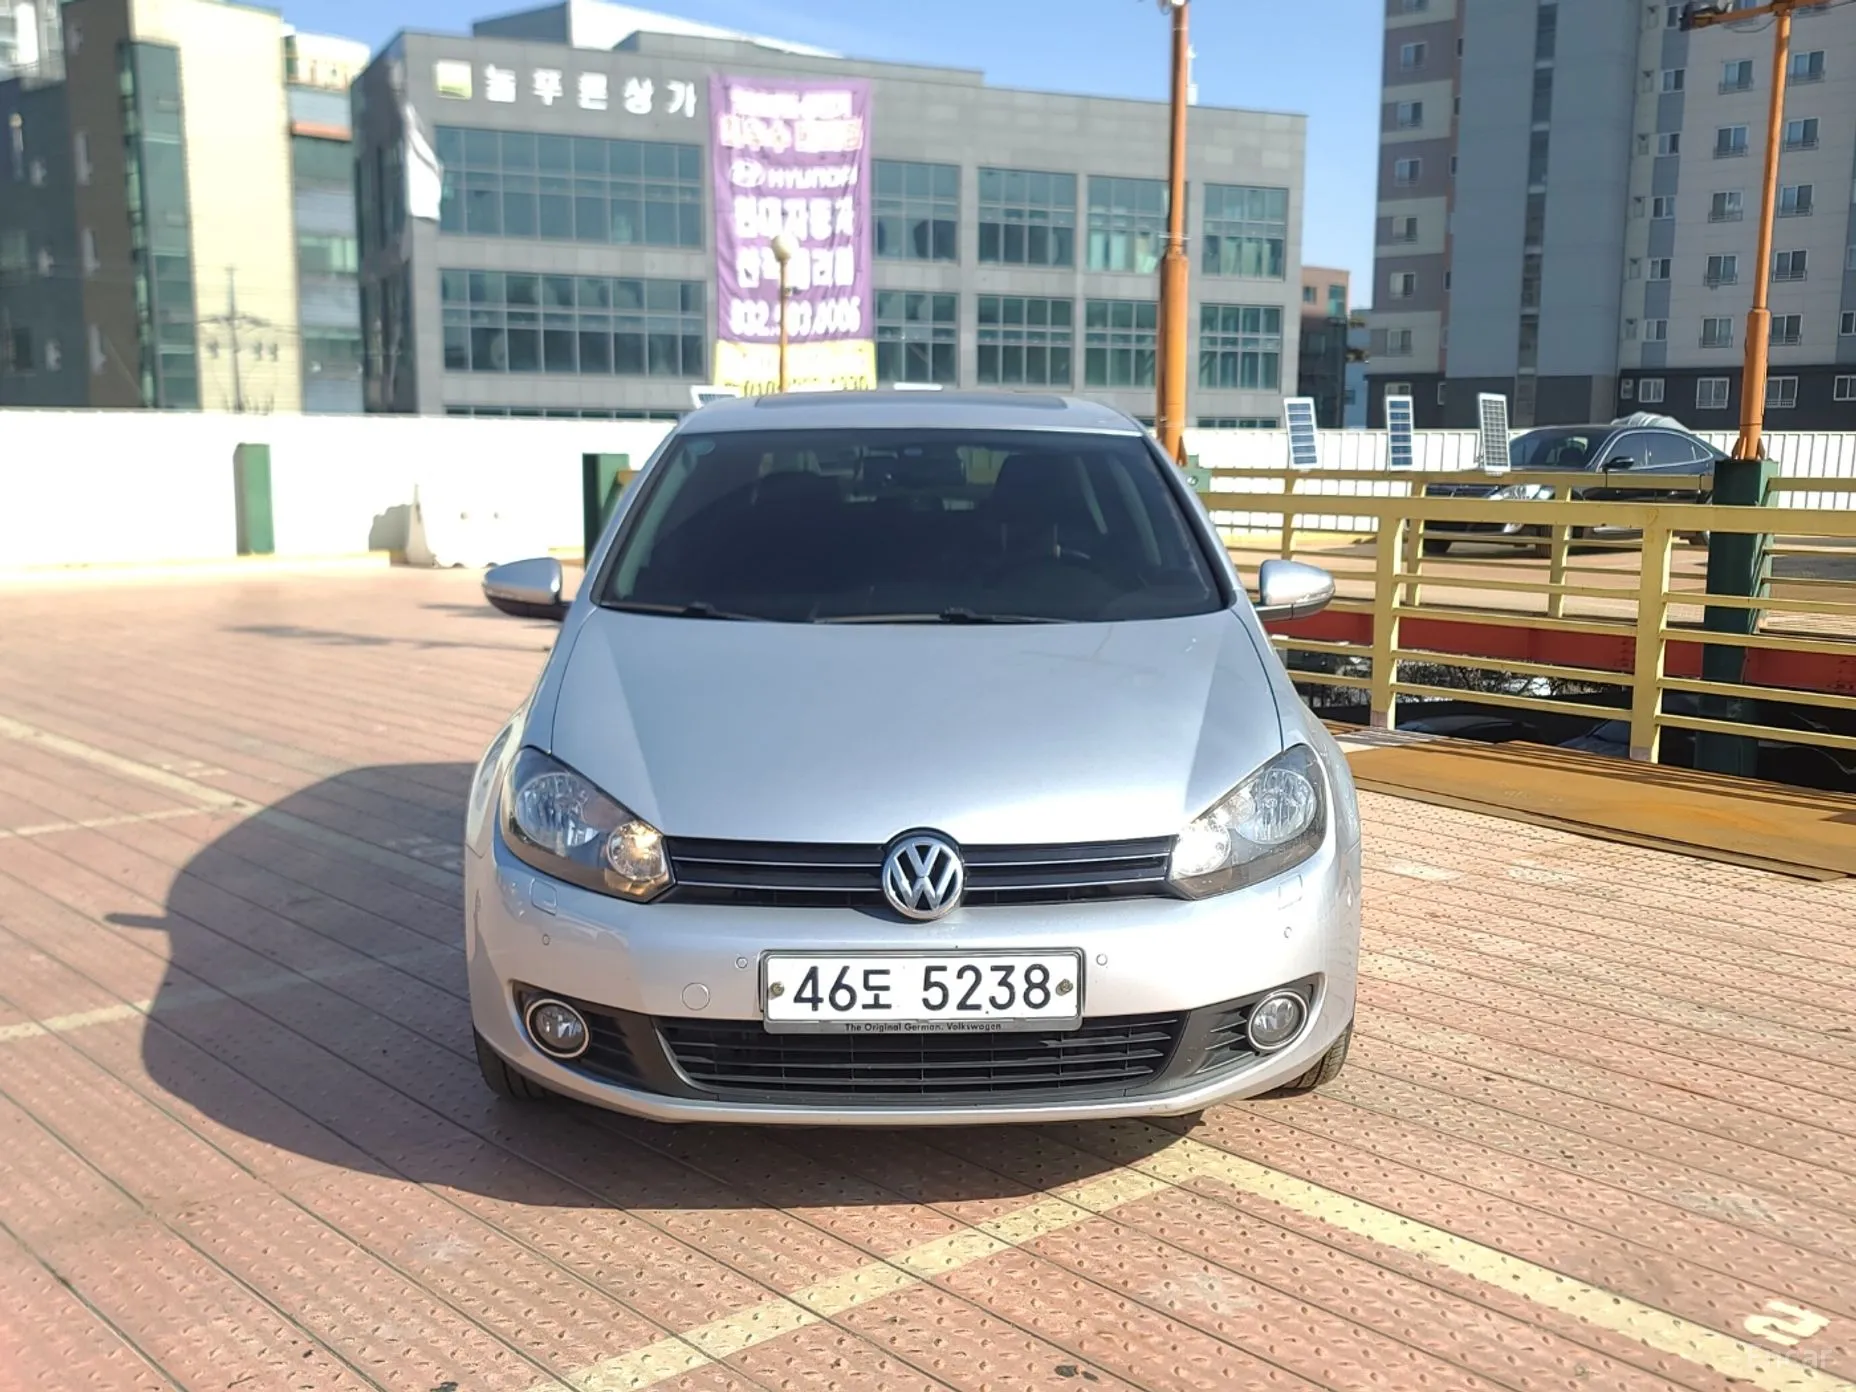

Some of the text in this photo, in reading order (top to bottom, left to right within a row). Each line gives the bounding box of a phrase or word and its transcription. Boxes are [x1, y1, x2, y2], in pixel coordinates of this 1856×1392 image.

[793, 963, 1051, 1012] 46도 5238
[846, 1023, 862, 1032] The
[864, 1023, 901, 1033] Original
[946, 1022, 1002, 1033] Volkswagen
